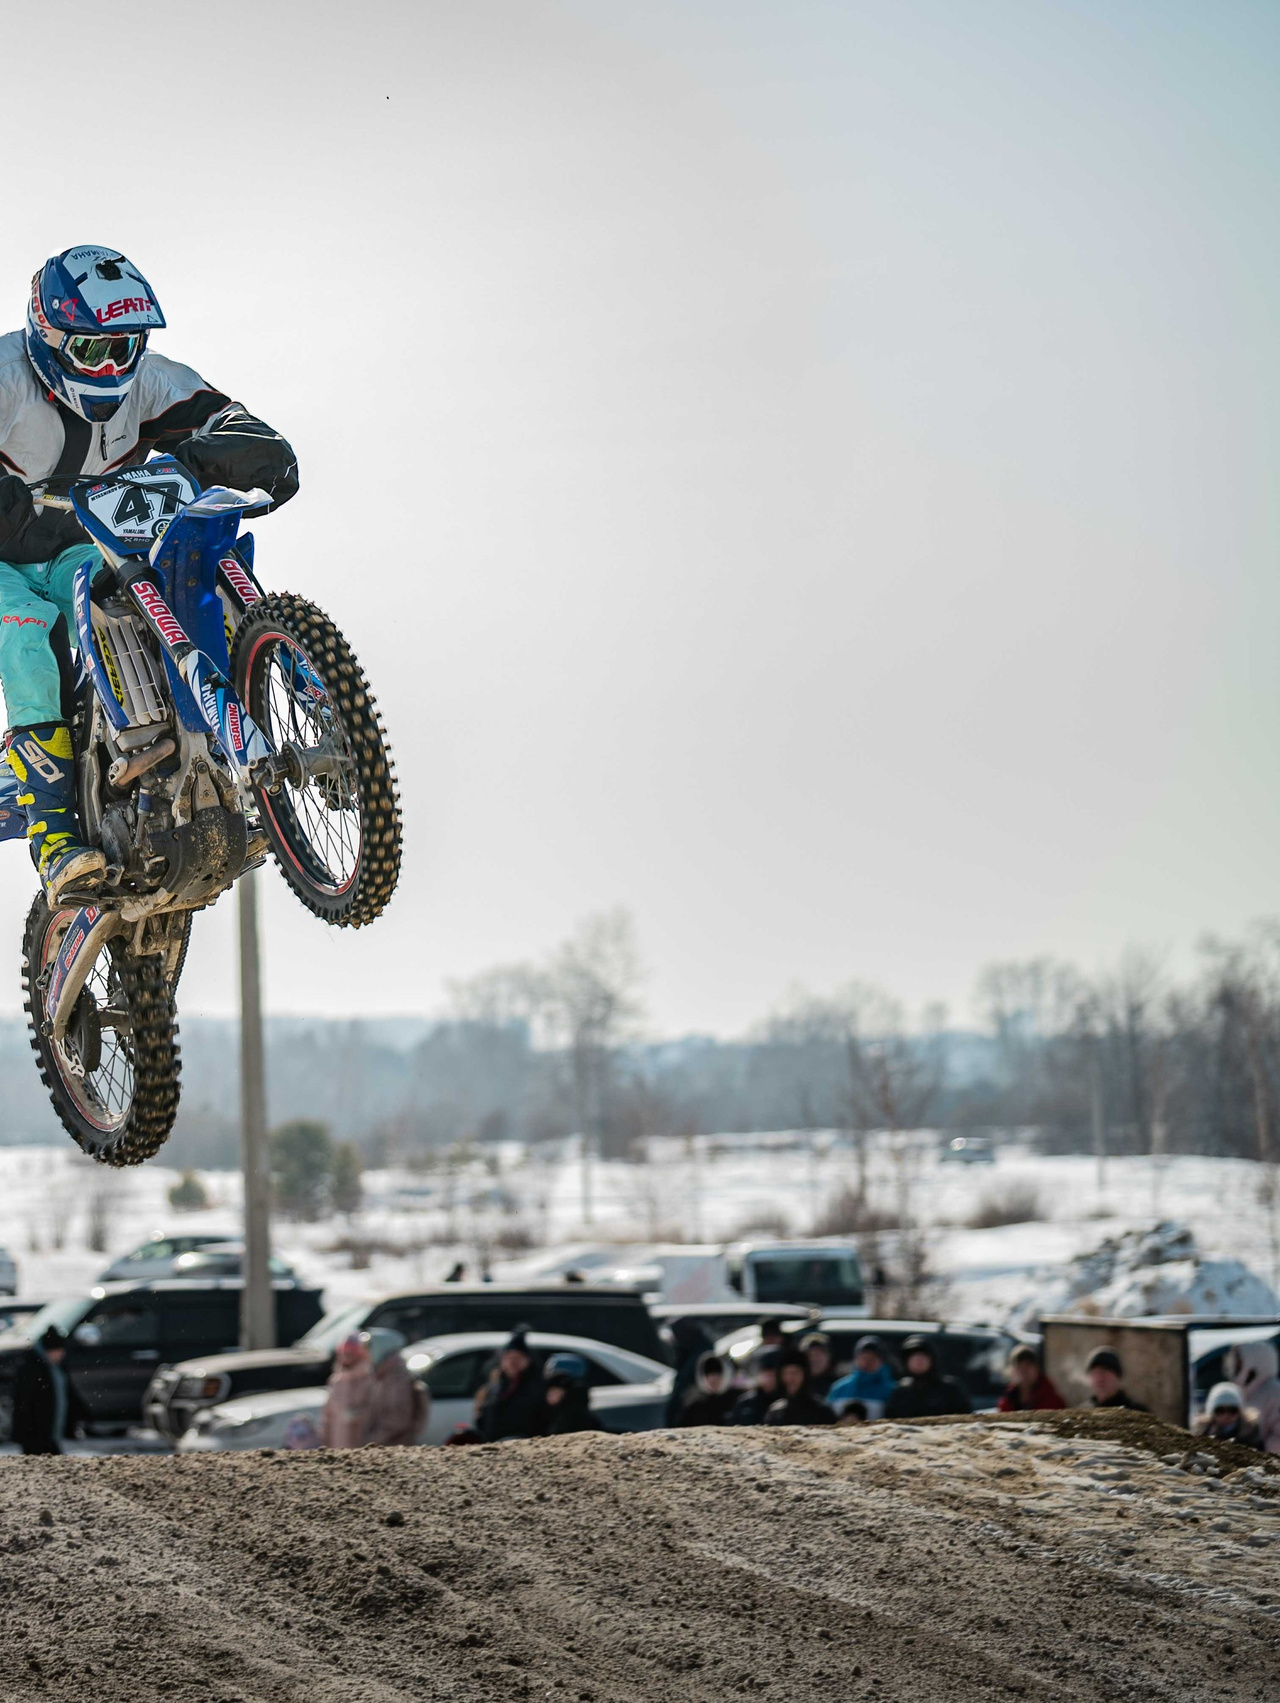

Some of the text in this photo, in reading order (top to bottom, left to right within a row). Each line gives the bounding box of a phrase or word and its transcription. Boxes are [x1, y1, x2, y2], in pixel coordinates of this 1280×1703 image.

[116, 469, 152, 481] MAHA
[112, 480, 184, 528] 47
[220, 559, 261, 607] OWA
[132, 581, 190, 647] SHOWA
[202, 683, 221, 735] YAMAHA
[228, 703, 243, 750] BRAKING
